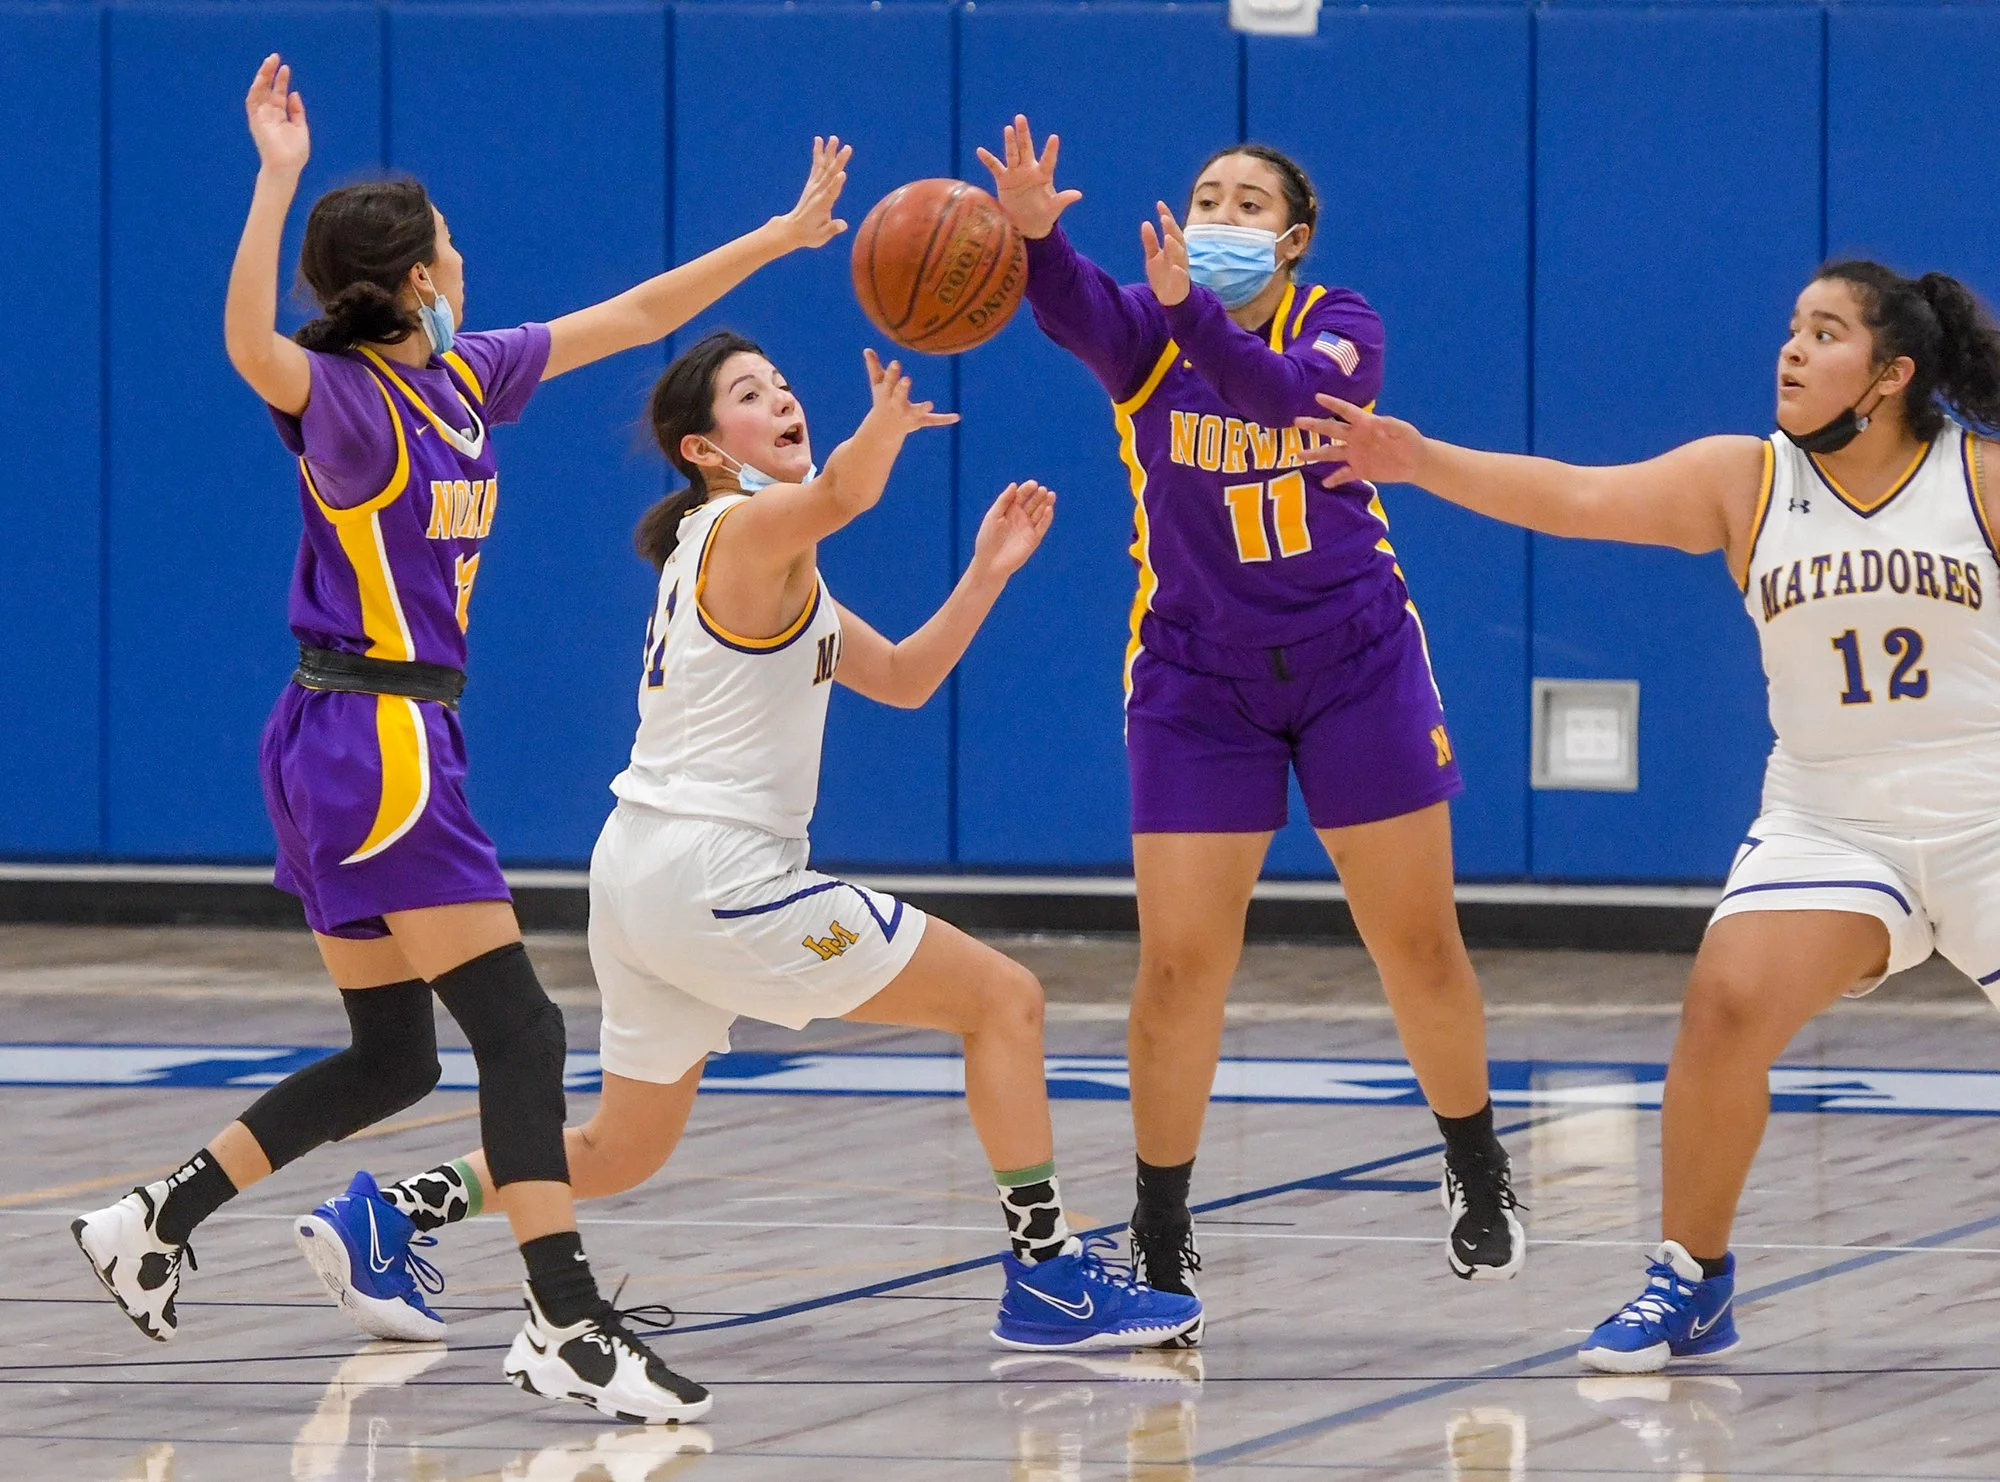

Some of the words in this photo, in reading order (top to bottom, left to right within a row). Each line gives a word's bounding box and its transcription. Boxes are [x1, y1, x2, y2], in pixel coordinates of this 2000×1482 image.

[1224, 459, 1312, 563] 11
[1760, 548, 1983, 623] MATADORES
[1830, 627, 1930, 706] 12
[1428, 723, 1453, 768] N
[801, 919, 860, 961] LM
